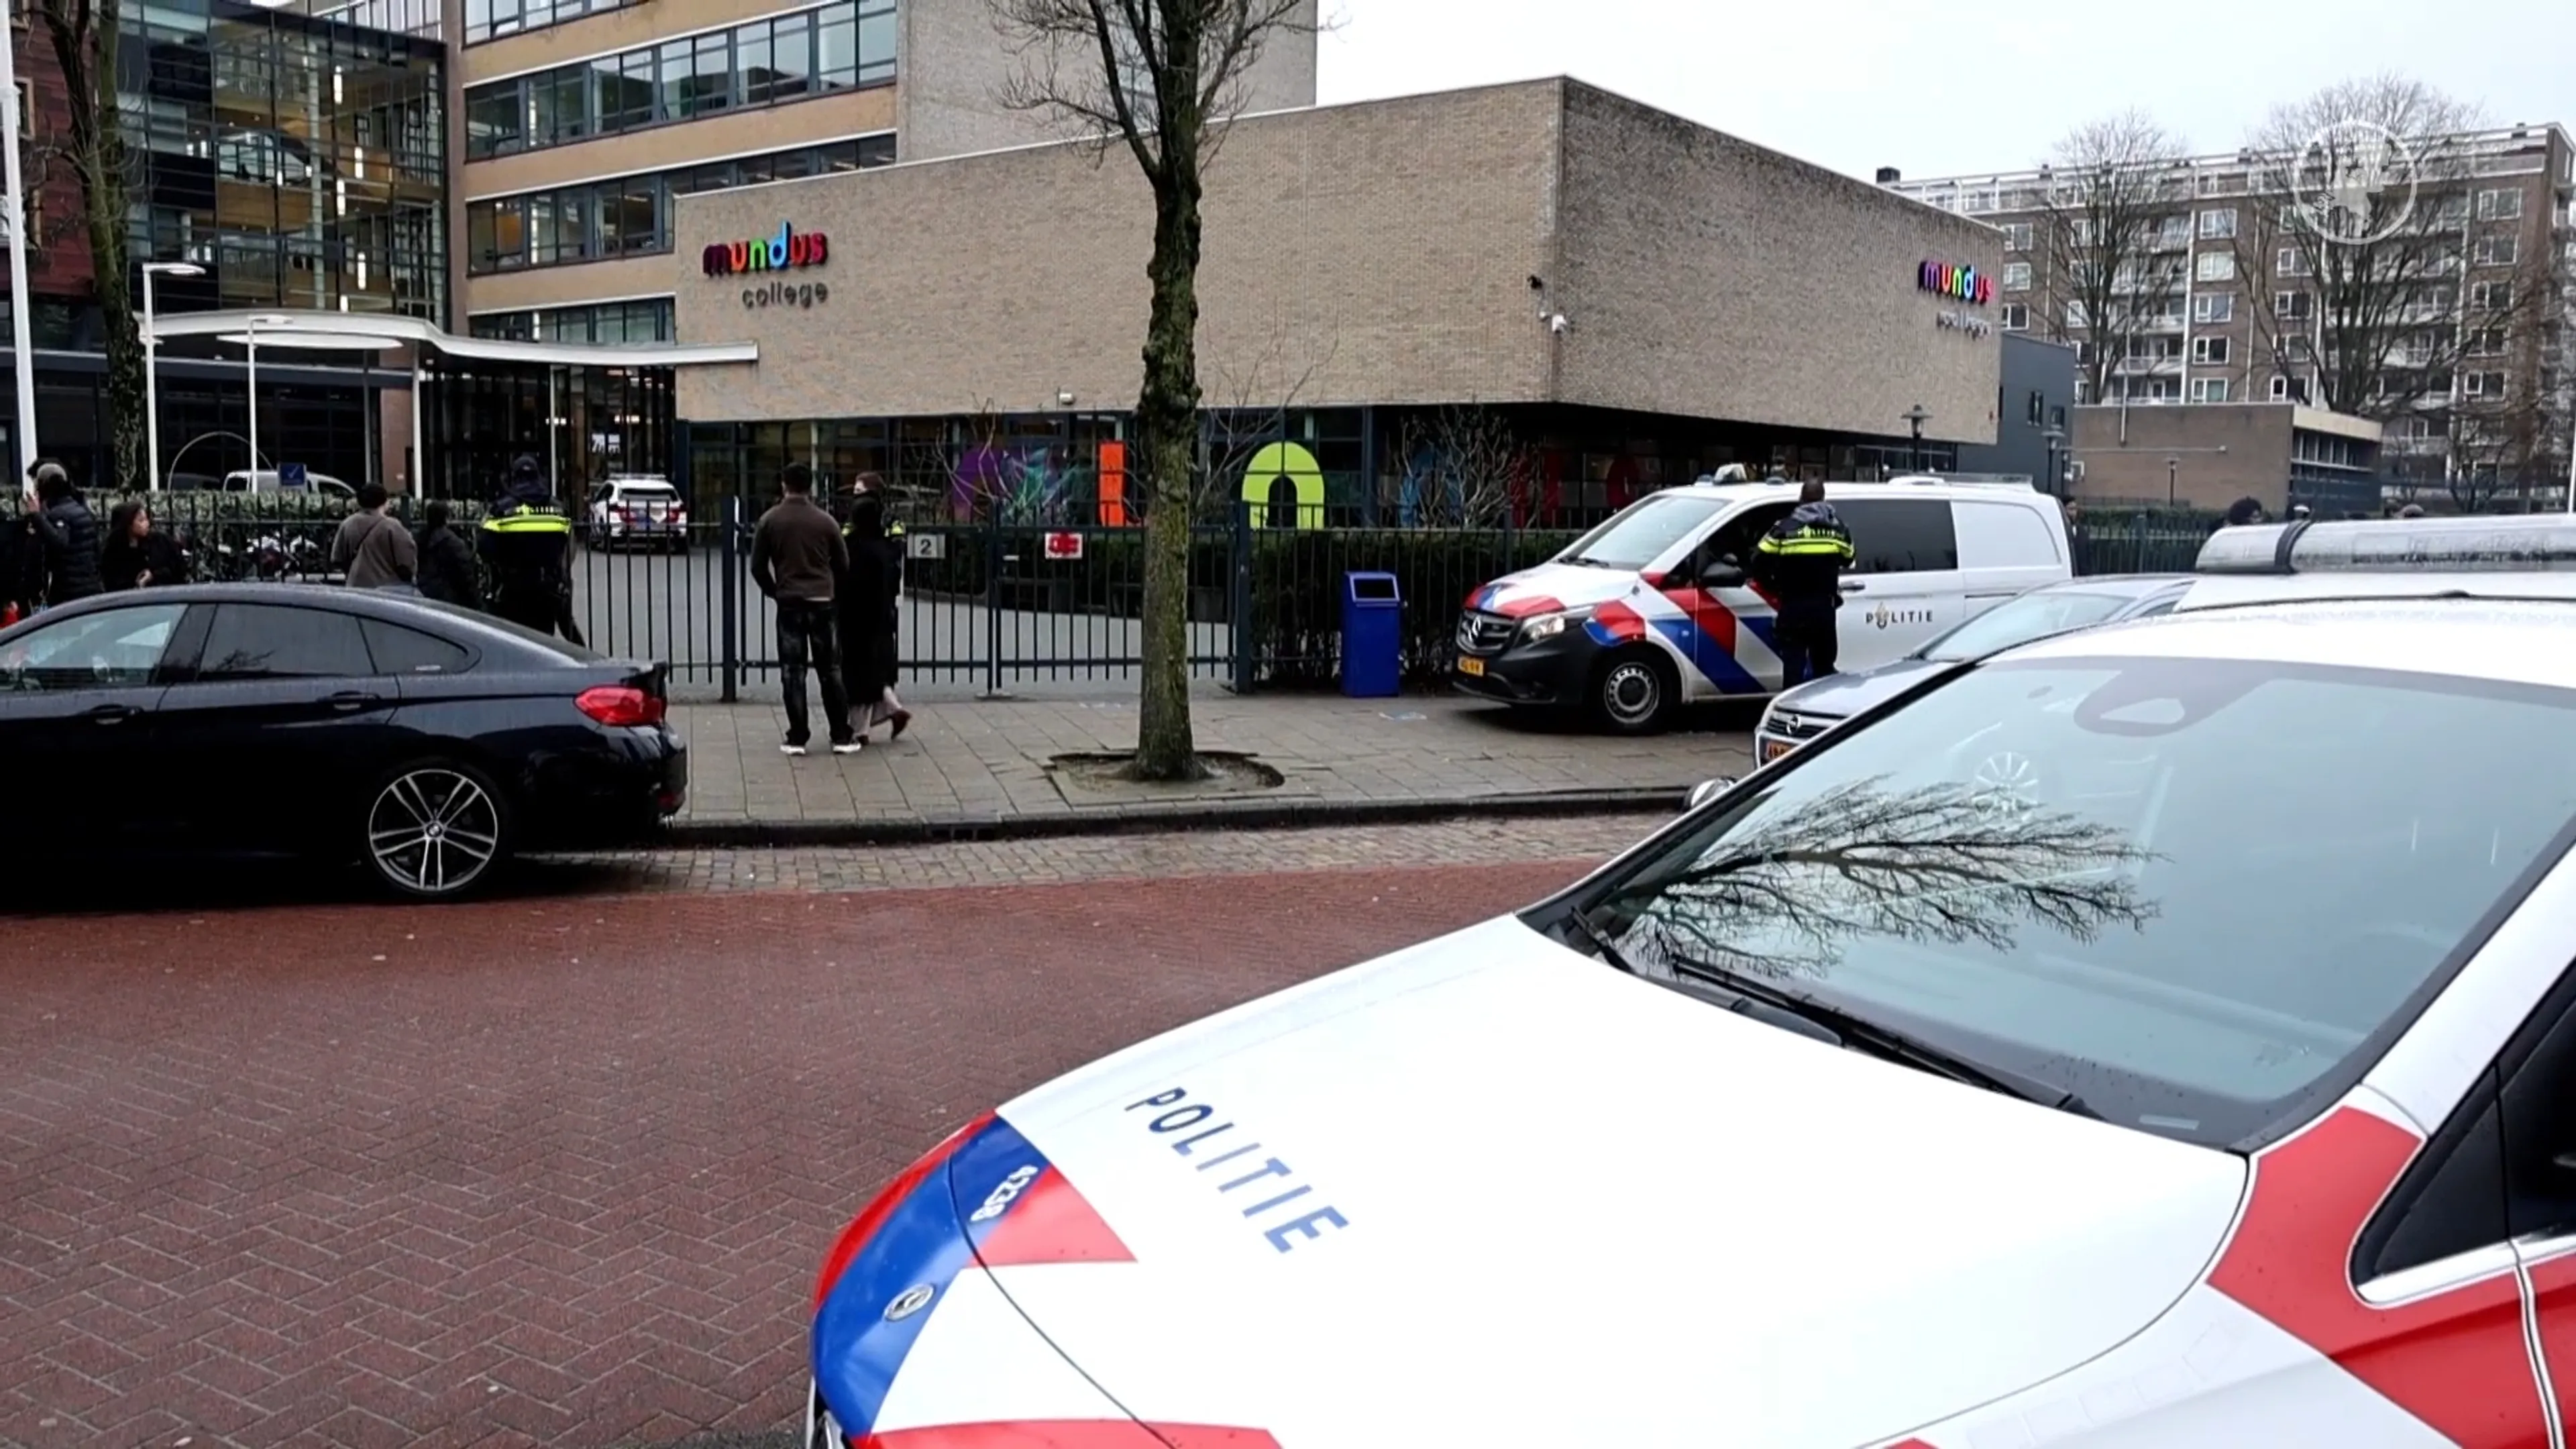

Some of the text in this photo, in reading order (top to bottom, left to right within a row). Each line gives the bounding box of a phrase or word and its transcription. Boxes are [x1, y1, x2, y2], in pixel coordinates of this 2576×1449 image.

[703, 219, 828, 276] mundus
[742, 281, 828, 309] college
[1919, 260, 1994, 305] mundus
[920, 539, 932, 555] 2
[1866, 610, 1933, 629] POLITIE
[1124, 1086, 1349, 1253] POLITIE
